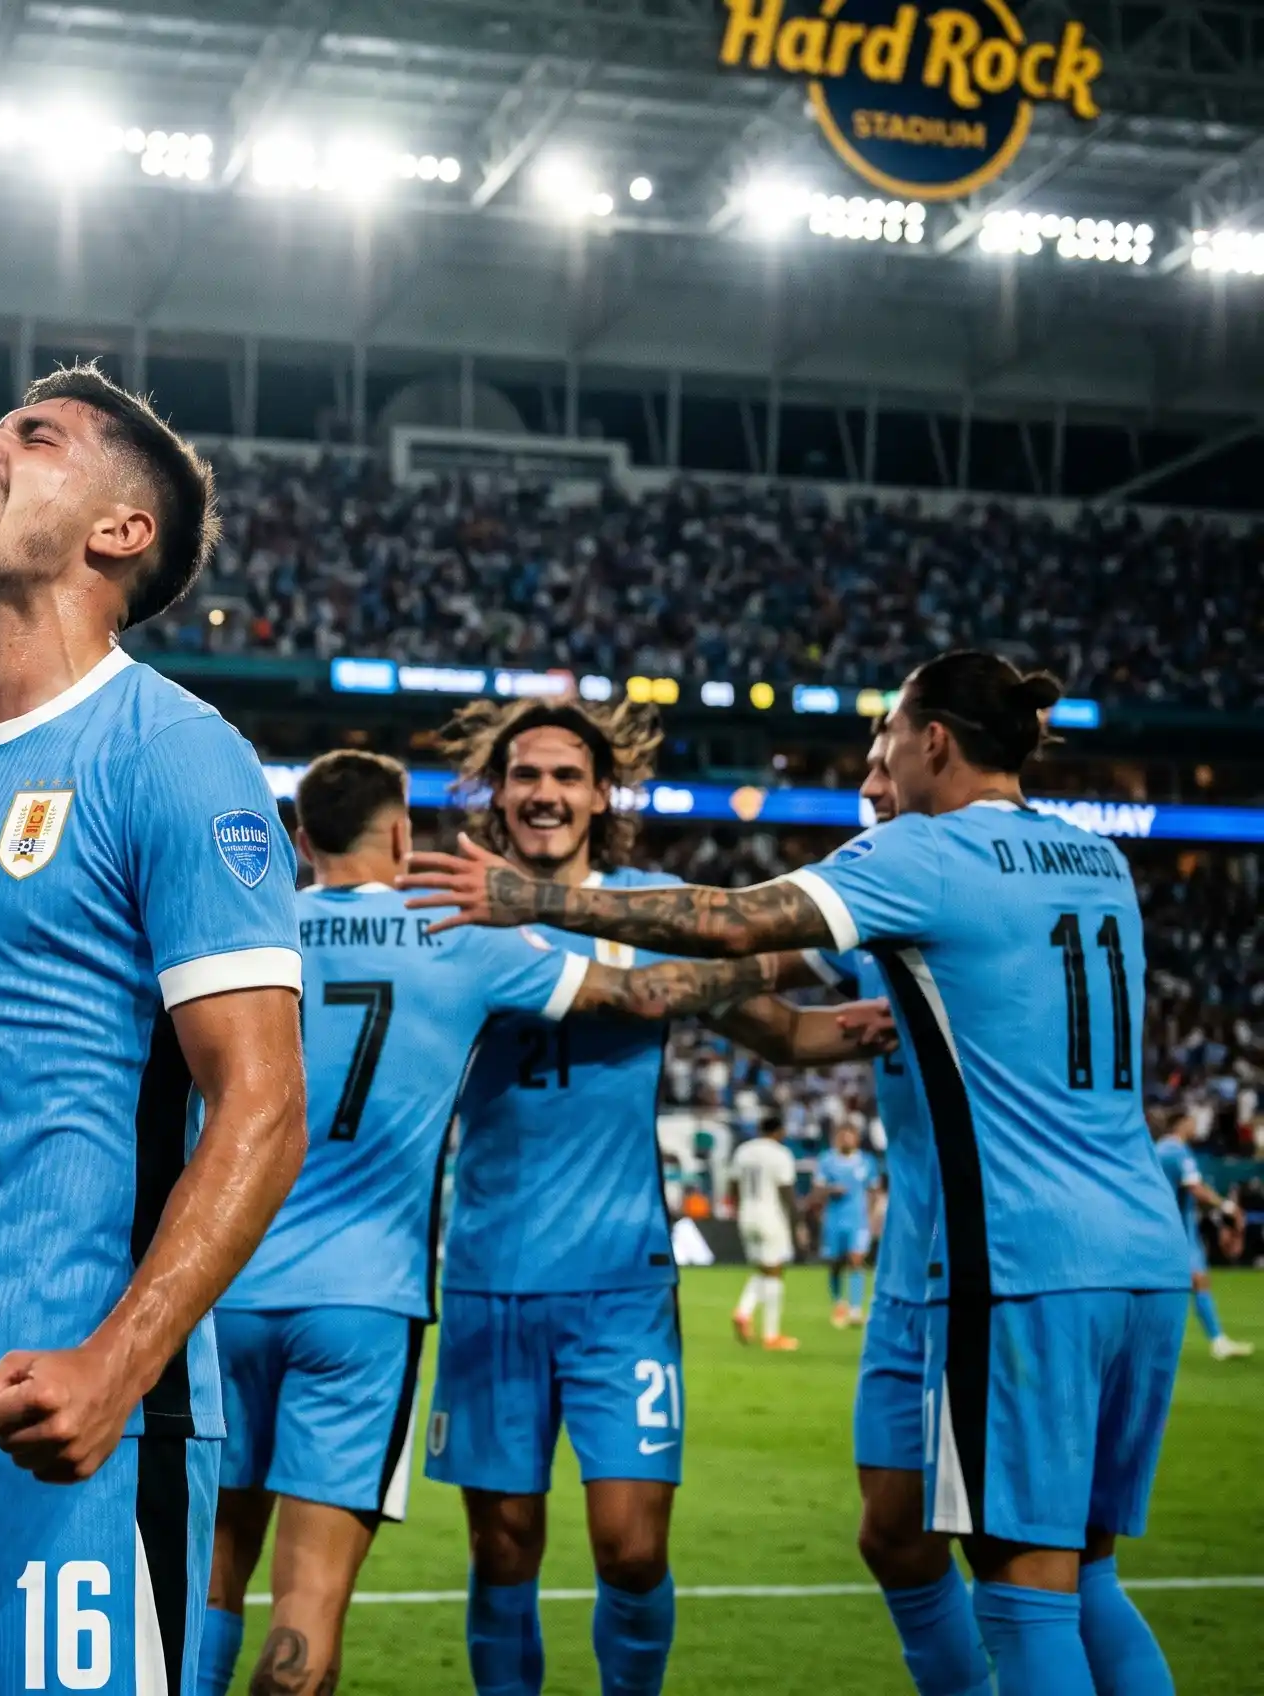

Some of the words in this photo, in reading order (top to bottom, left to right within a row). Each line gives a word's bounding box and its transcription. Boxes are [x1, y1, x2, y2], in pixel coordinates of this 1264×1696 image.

[720, 0, 918, 84] Hard
[922, 9, 1102, 120] Rock
[852, 109, 987, 150] STADIUM
[299, 980, 395, 1142] 7
[517, 1022, 570, 1089] 21
[1049, 912, 1134, 1091] 11
[634, 1358, 680, 1429] 21
[16, 1560, 111, 1690] 16
